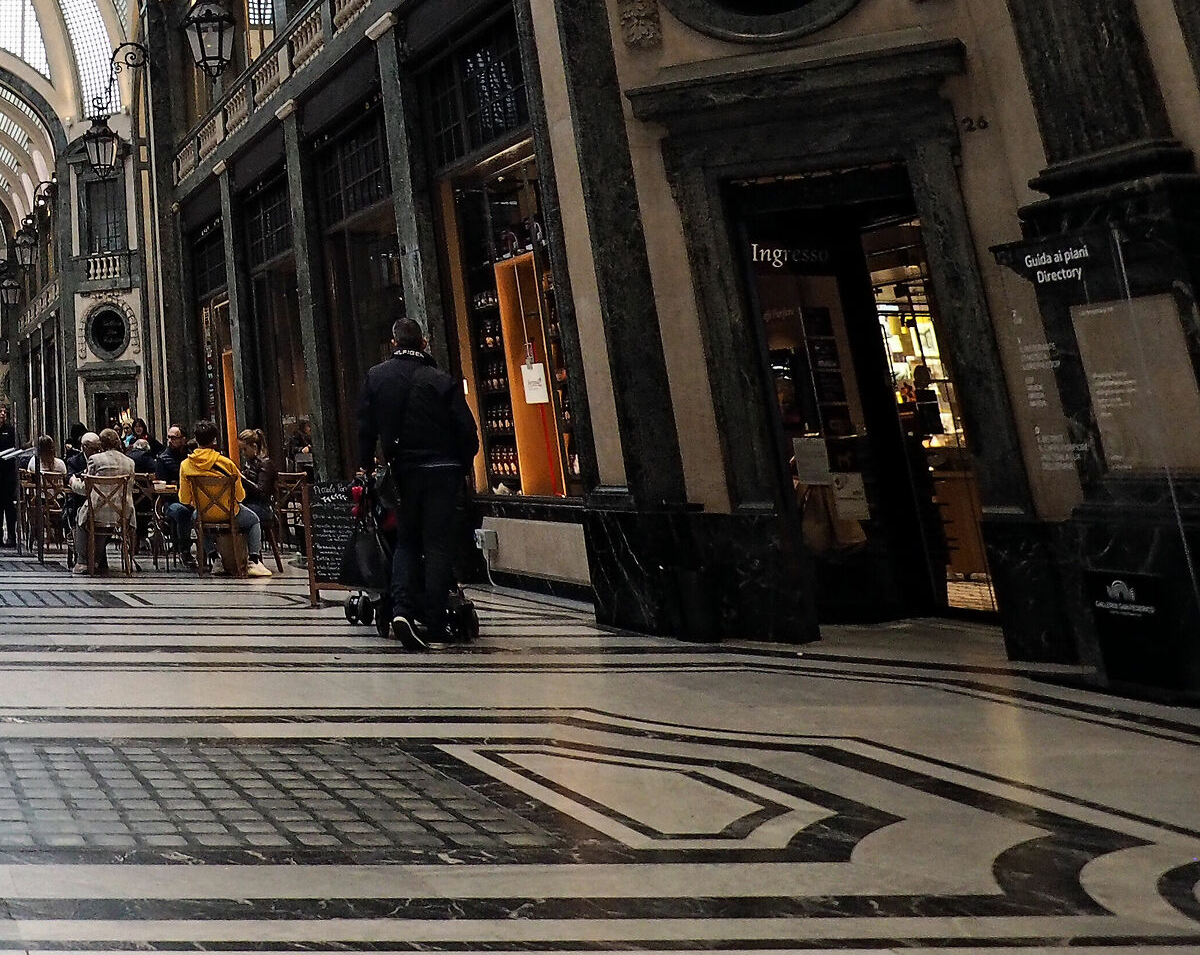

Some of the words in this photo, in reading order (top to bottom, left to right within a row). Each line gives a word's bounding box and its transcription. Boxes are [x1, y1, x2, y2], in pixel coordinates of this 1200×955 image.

[961, 115, 989, 133] 26
[751, 243, 830, 268] Ingresso
[1024, 249, 1052, 268] Guida
[1053, 249, 1064, 263] ai
[1063, 244, 1089, 265] piani
[1036, 266, 1083, 285] Directory
